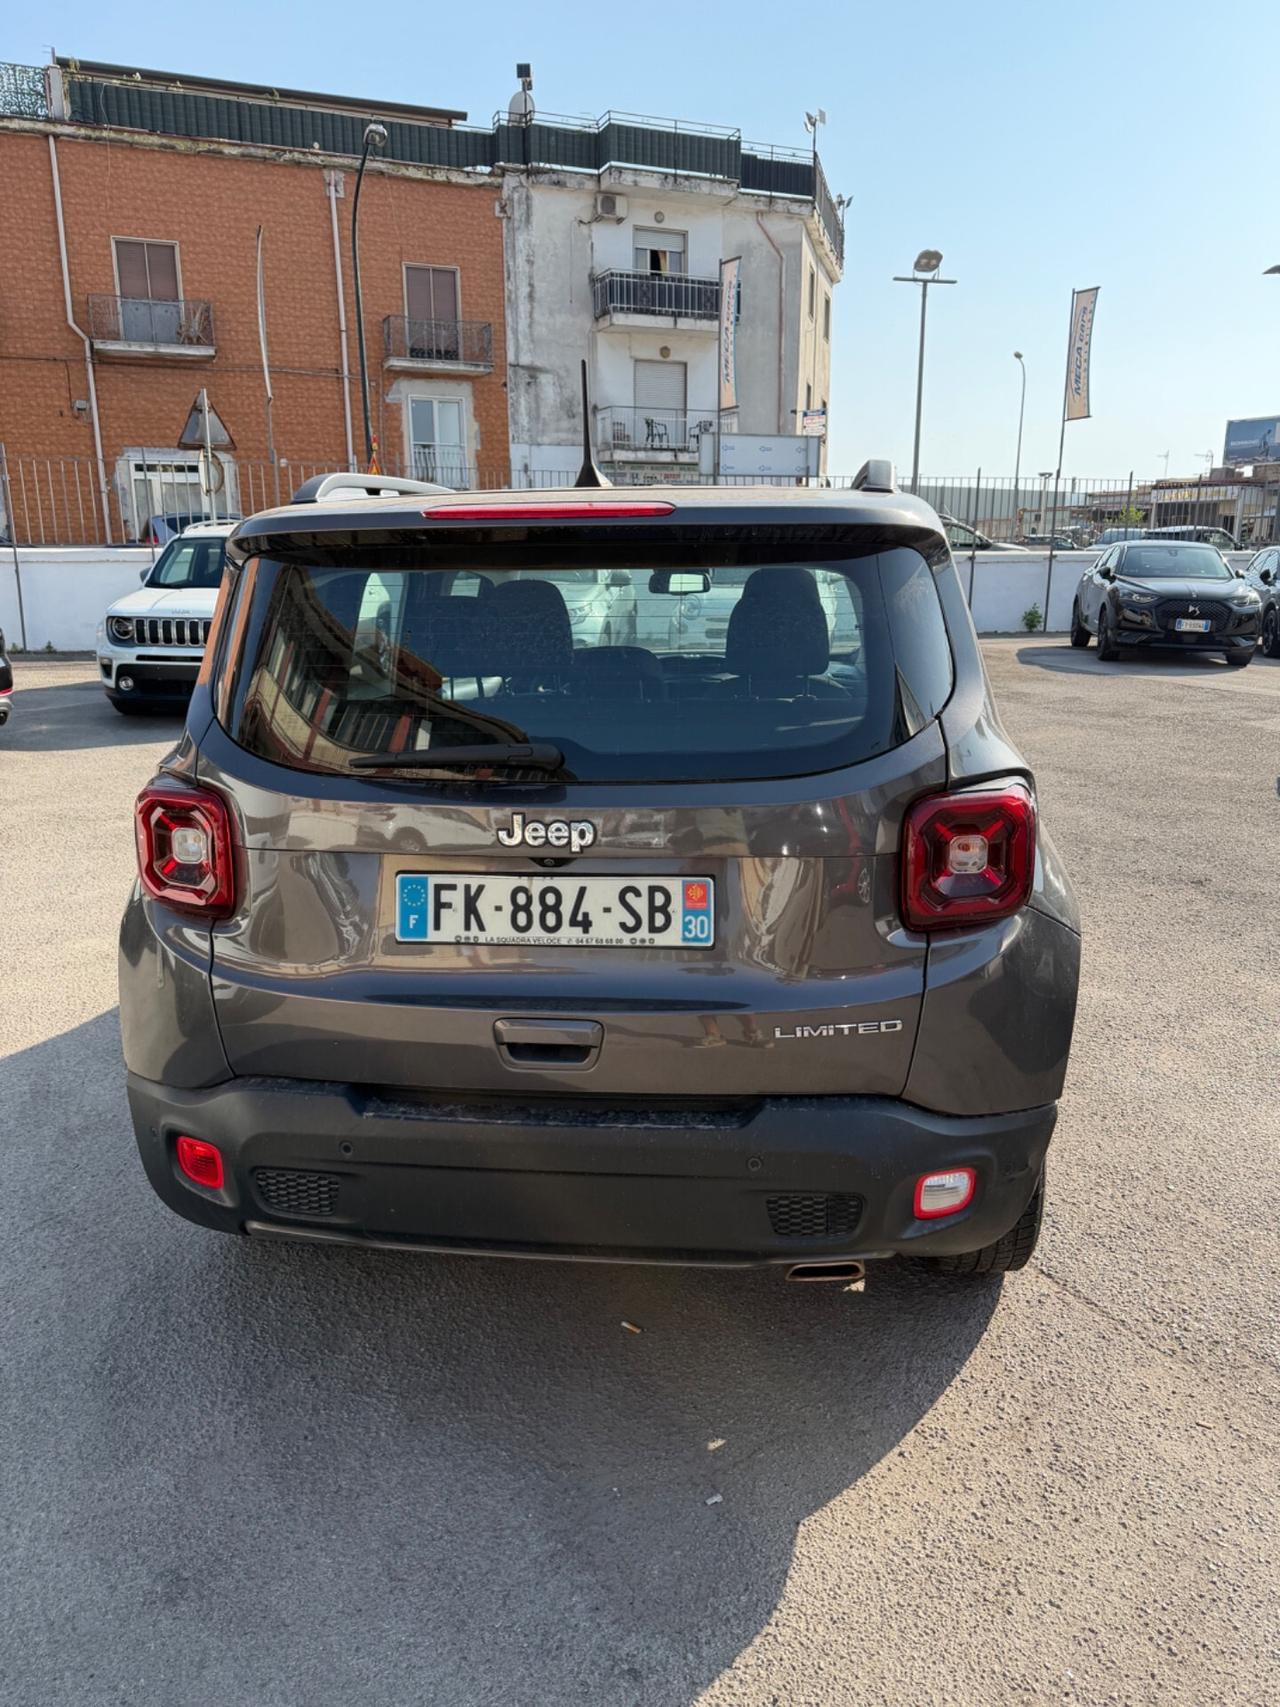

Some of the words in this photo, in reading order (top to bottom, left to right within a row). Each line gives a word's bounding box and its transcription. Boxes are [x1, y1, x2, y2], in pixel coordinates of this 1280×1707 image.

[497, 813, 596, 853] Jeep
[432, 883, 673, 935] FK-884-SB
[409, 914, 418, 929] F
[684, 915, 708, 938] 30
[497, 936, 532, 944] SQUADRA
[533, 937, 562, 945] VELOCE
[774, 1020, 902, 1038] LIMITED
